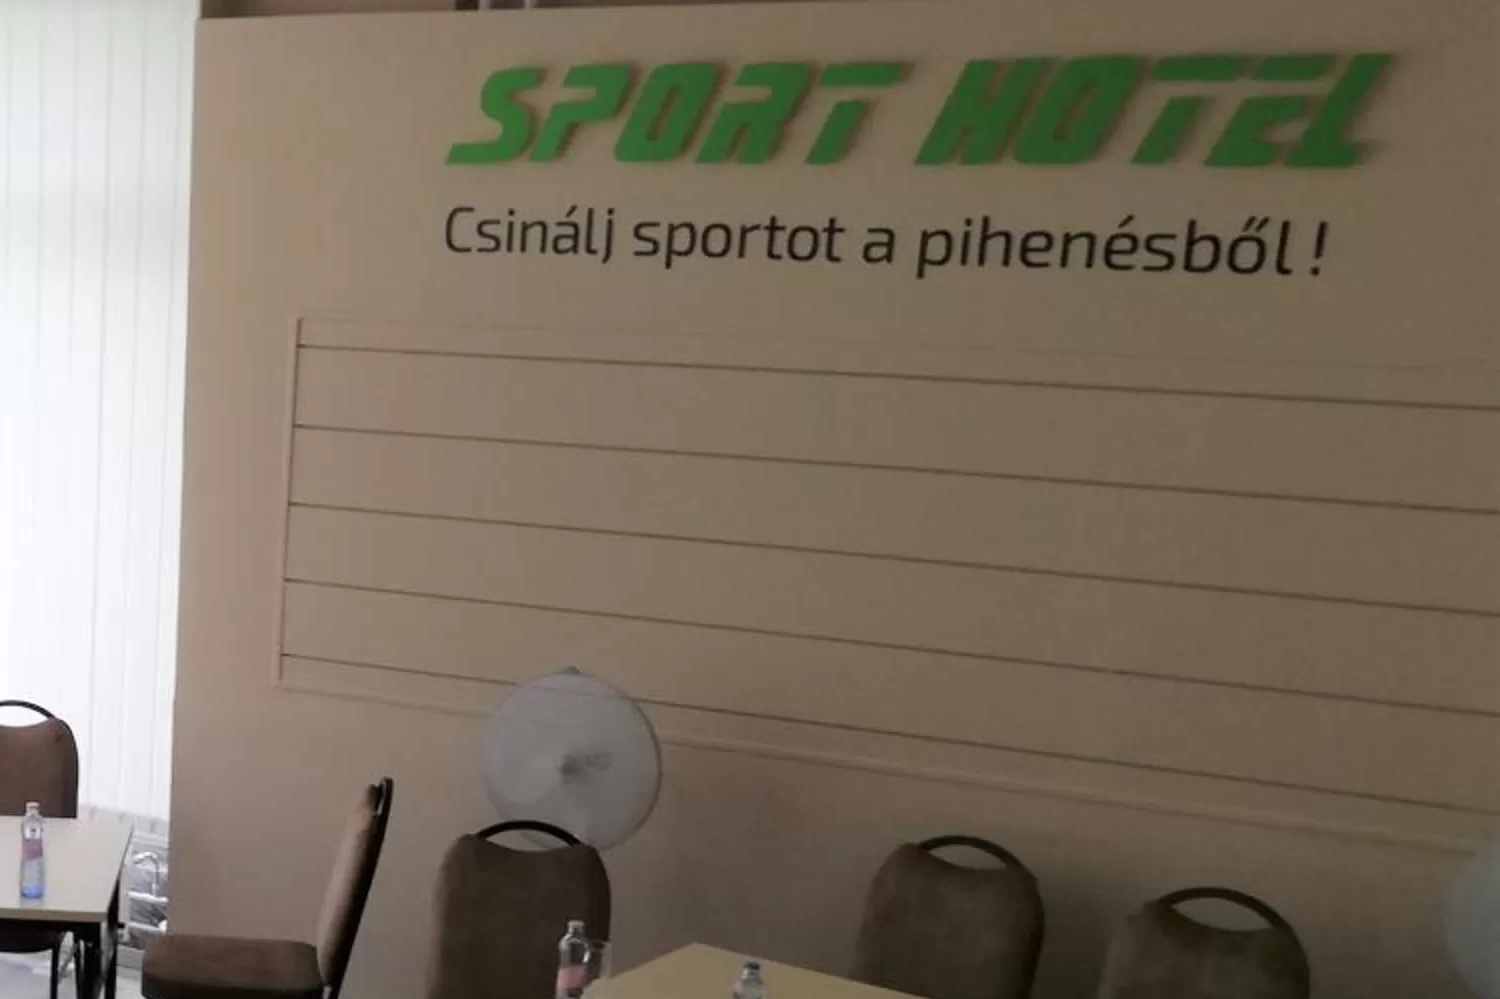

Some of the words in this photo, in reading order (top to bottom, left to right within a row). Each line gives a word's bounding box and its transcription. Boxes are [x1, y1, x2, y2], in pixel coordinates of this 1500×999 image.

[445, 61, 915, 166] SPORT
[913, 53, 1396, 169] HOTEL
[444, 205, 615, 264] Csinálj
[632, 216, 846, 270] sportot
[862, 226, 896, 265] a
